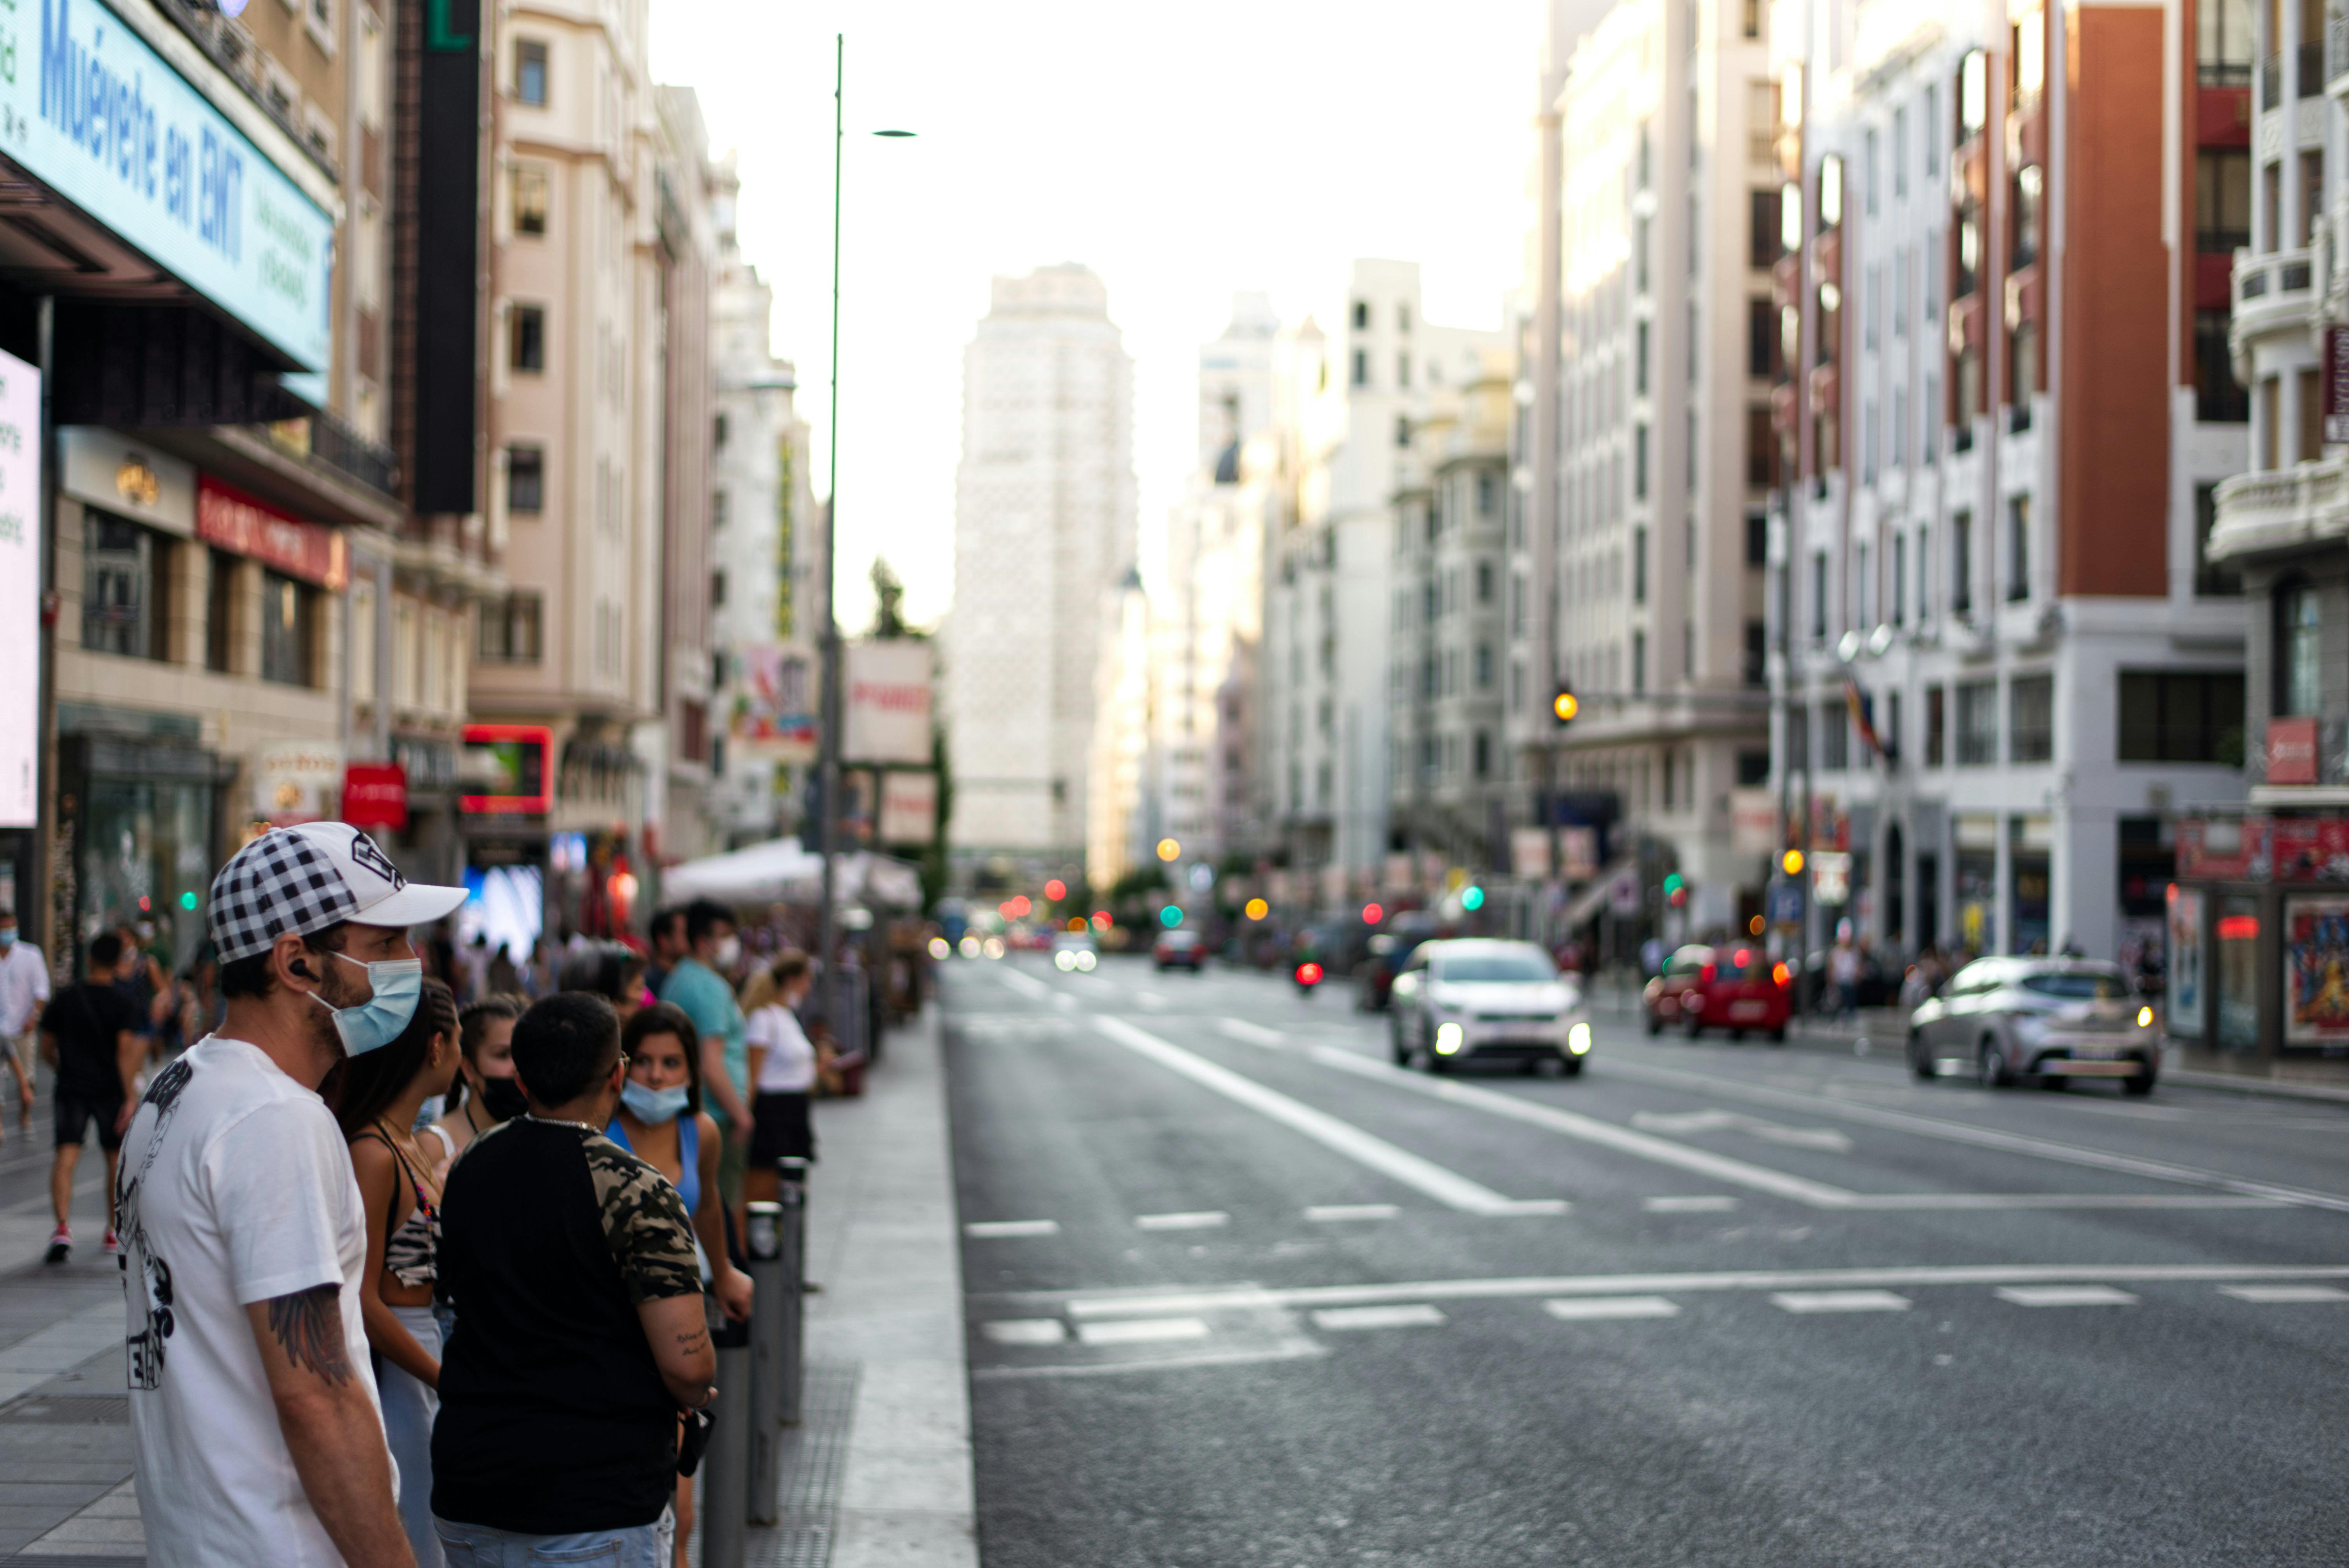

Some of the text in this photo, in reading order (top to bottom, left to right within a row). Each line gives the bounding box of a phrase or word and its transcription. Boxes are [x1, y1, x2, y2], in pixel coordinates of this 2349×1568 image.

[40, 0, 158, 202] Muévete
[167, 125, 191, 227] en
[200, 123, 243, 269] EMT
